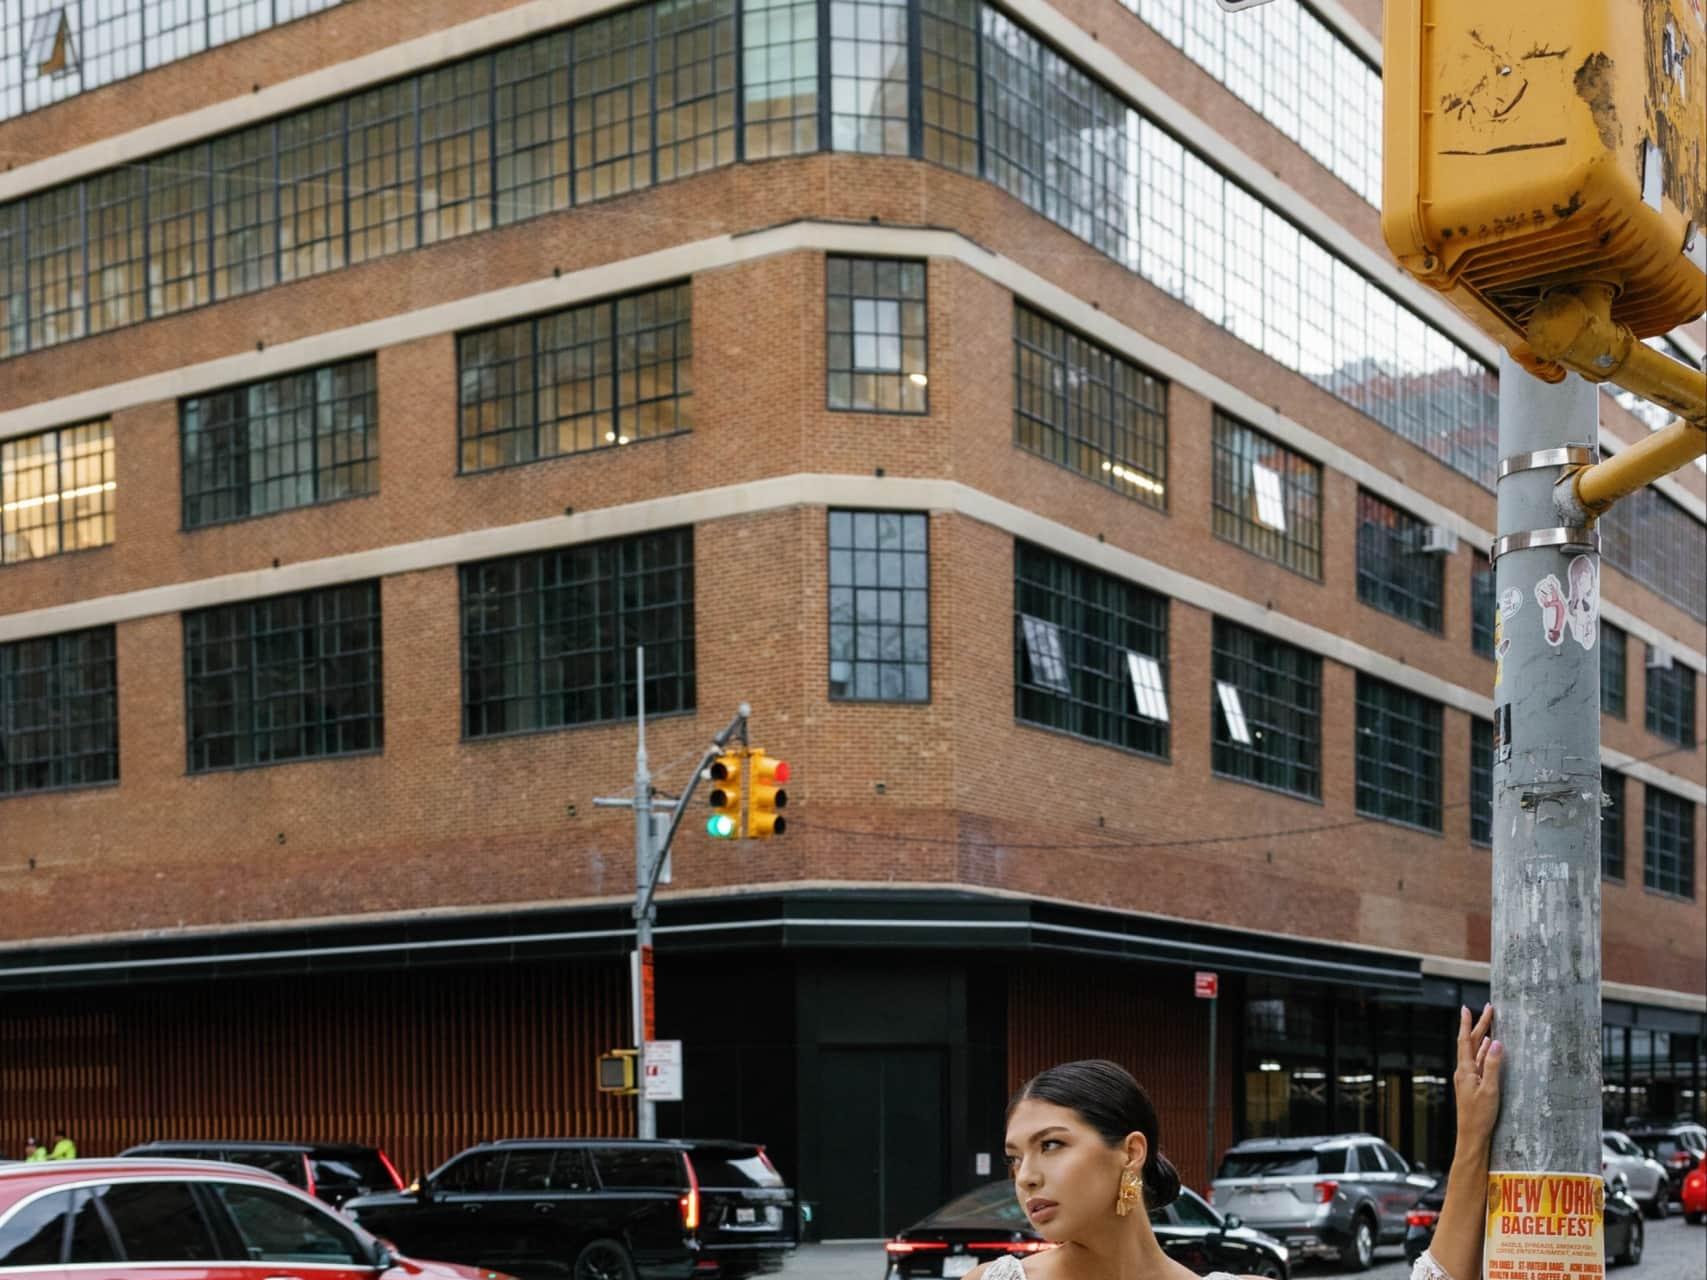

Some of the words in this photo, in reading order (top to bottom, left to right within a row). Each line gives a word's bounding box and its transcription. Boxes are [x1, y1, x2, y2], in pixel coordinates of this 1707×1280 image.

[1501, 1178, 1543, 1213] NEW
[1548, 1178, 1594, 1215] YORK
[1501, 1215, 1594, 1237] BAGELFEST
